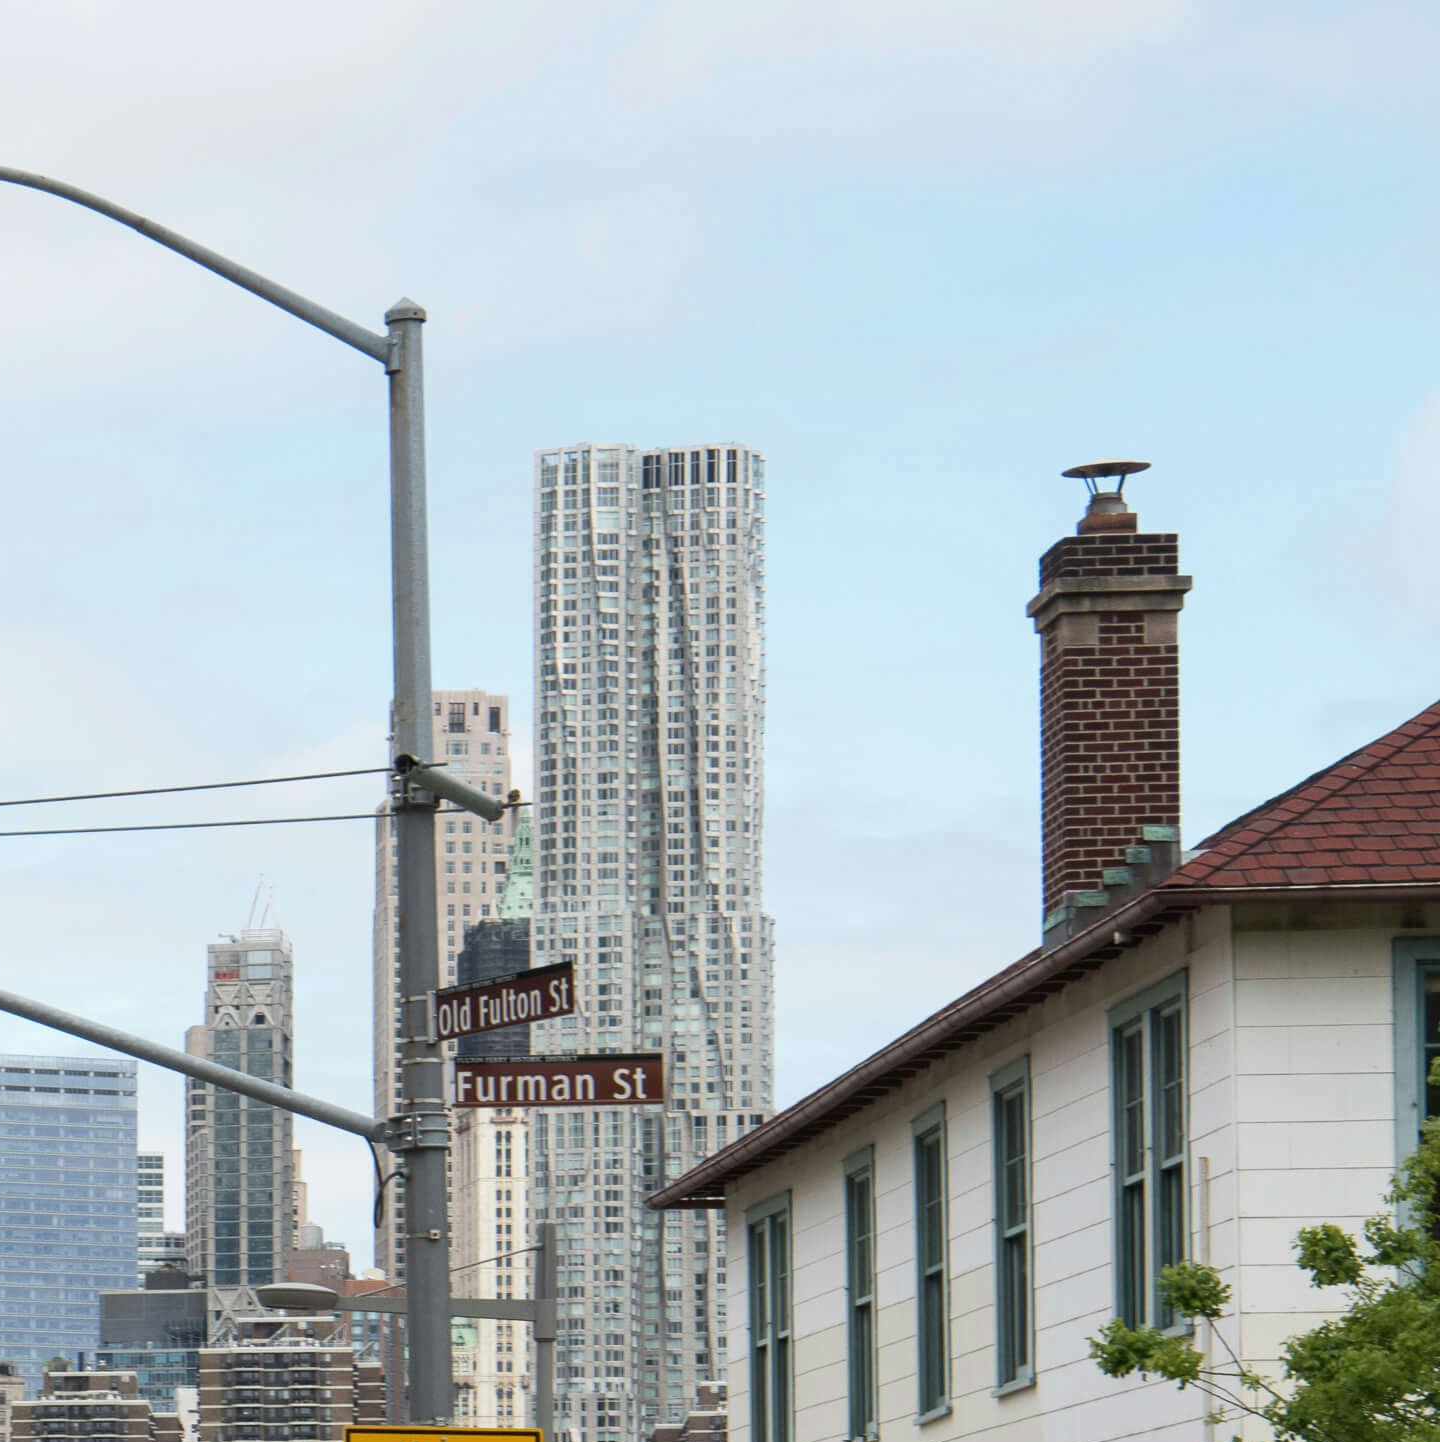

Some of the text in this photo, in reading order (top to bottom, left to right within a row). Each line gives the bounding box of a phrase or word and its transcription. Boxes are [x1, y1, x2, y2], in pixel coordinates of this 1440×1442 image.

[438, 996, 472, 1036] Old
[478, 988, 543, 1028] Fulton
[549, 977, 570, 1013] St
[457, 1067, 647, 1103] Furman St
